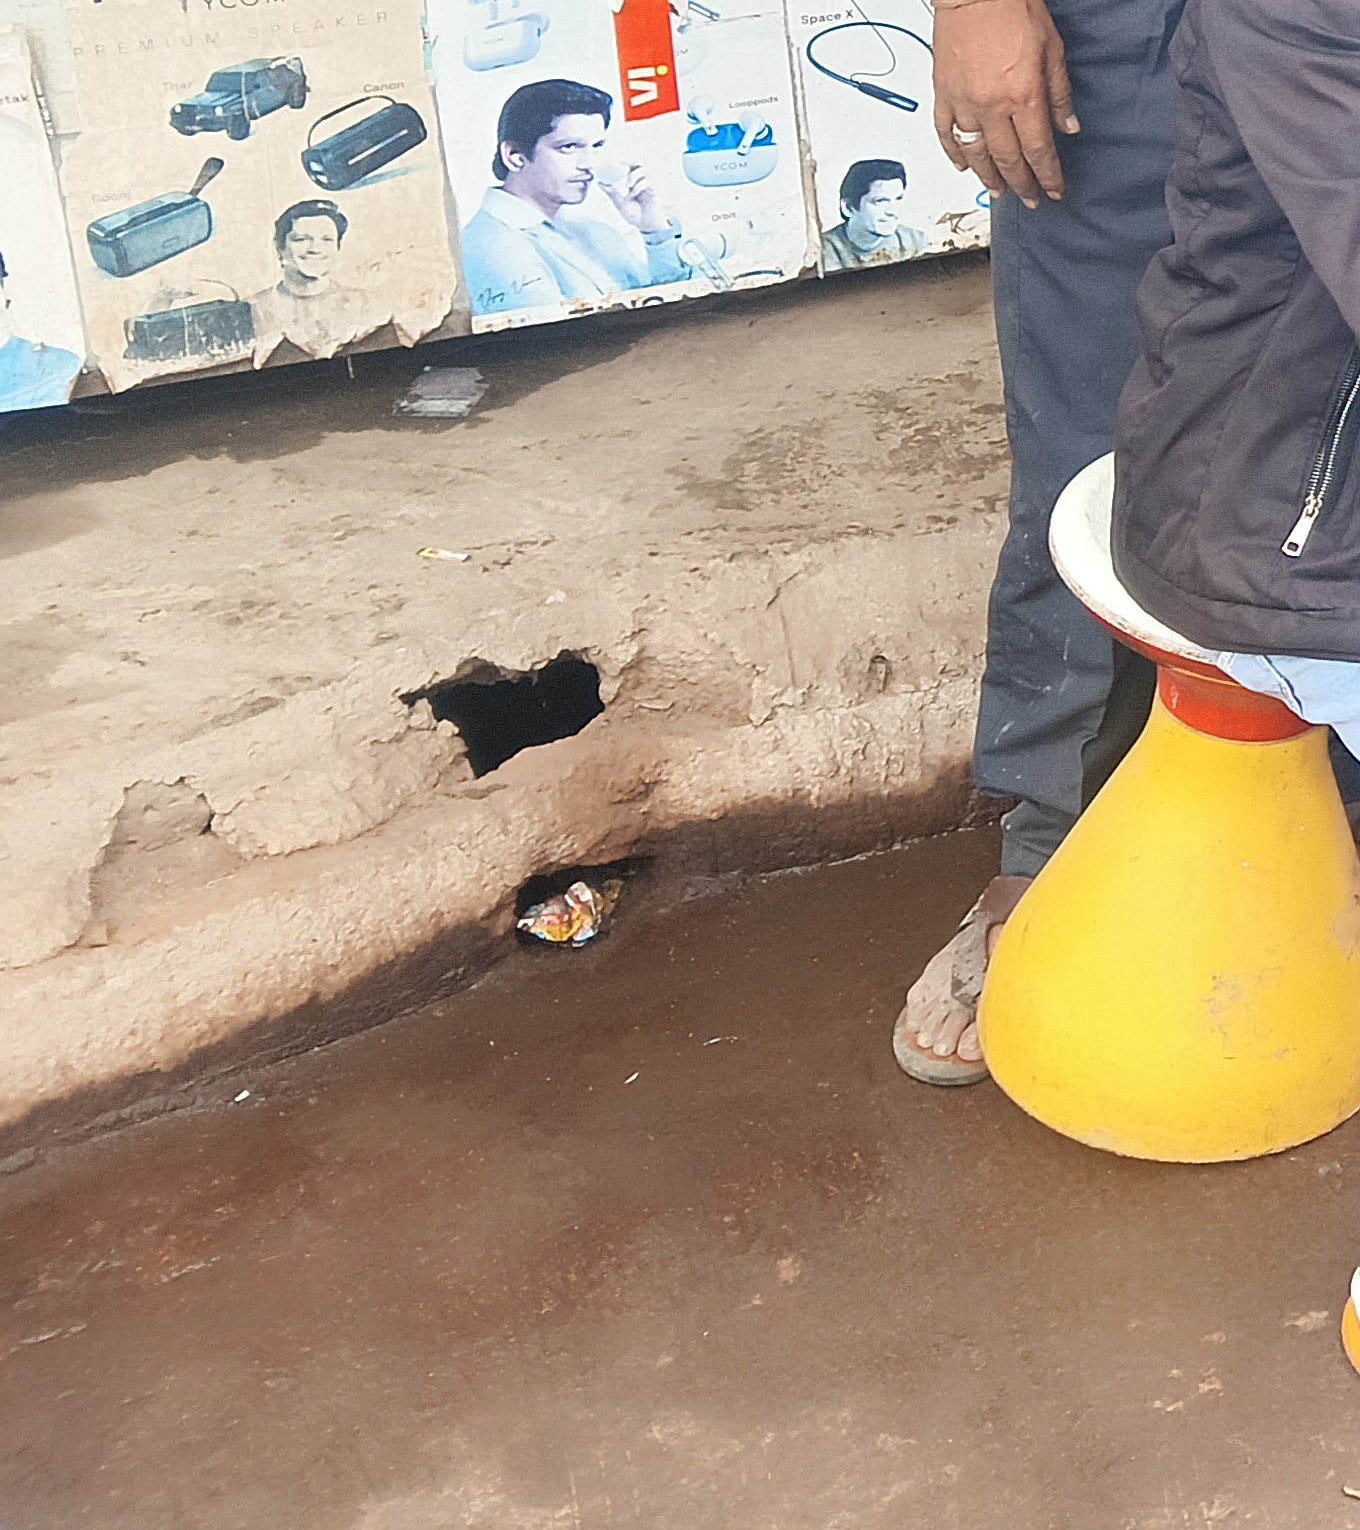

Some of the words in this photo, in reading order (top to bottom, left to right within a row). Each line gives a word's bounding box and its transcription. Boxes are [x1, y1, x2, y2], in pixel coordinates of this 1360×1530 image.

[800, 12, 842, 26] Space
[845, 9, 855, 20] X
[73, 32, 222, 60] PREMIUM
[248, 11, 389, 40] SPEAKER
[363, 79, 406, 93] Canon
[728, 95, 779, 109] Looppods
[713, 161, 749, 171] YCOM
[711, 211, 737, 222] Orbit
